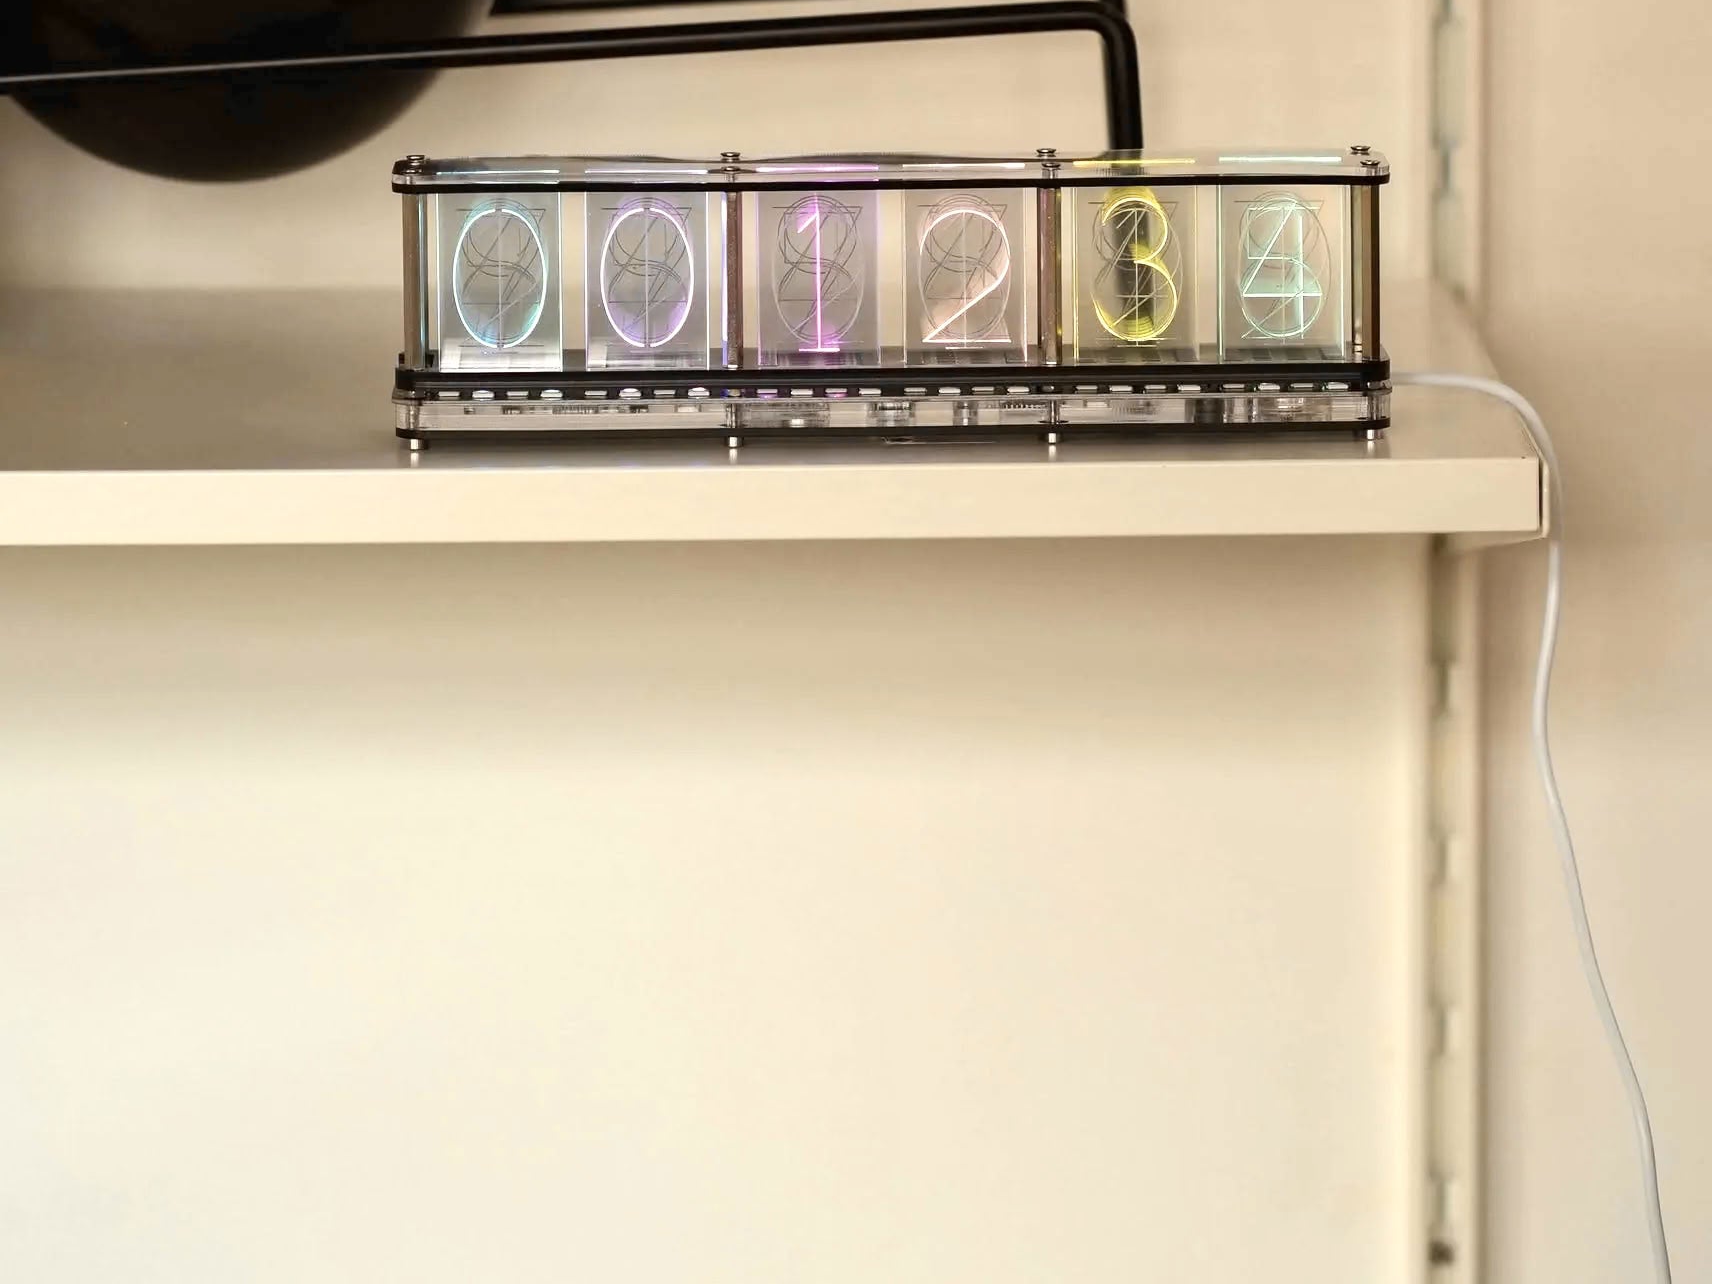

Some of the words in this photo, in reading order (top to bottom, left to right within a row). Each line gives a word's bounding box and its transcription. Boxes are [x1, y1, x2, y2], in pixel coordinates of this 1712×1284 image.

[453, 207, 548, 348] 0
[600, 207, 695, 348] 0
[797, 208, 841, 352] 1
[919, 209, 1012, 343] 2
[1092, 197, 1178, 341] 3
[1242, 202, 1323, 340] 4
